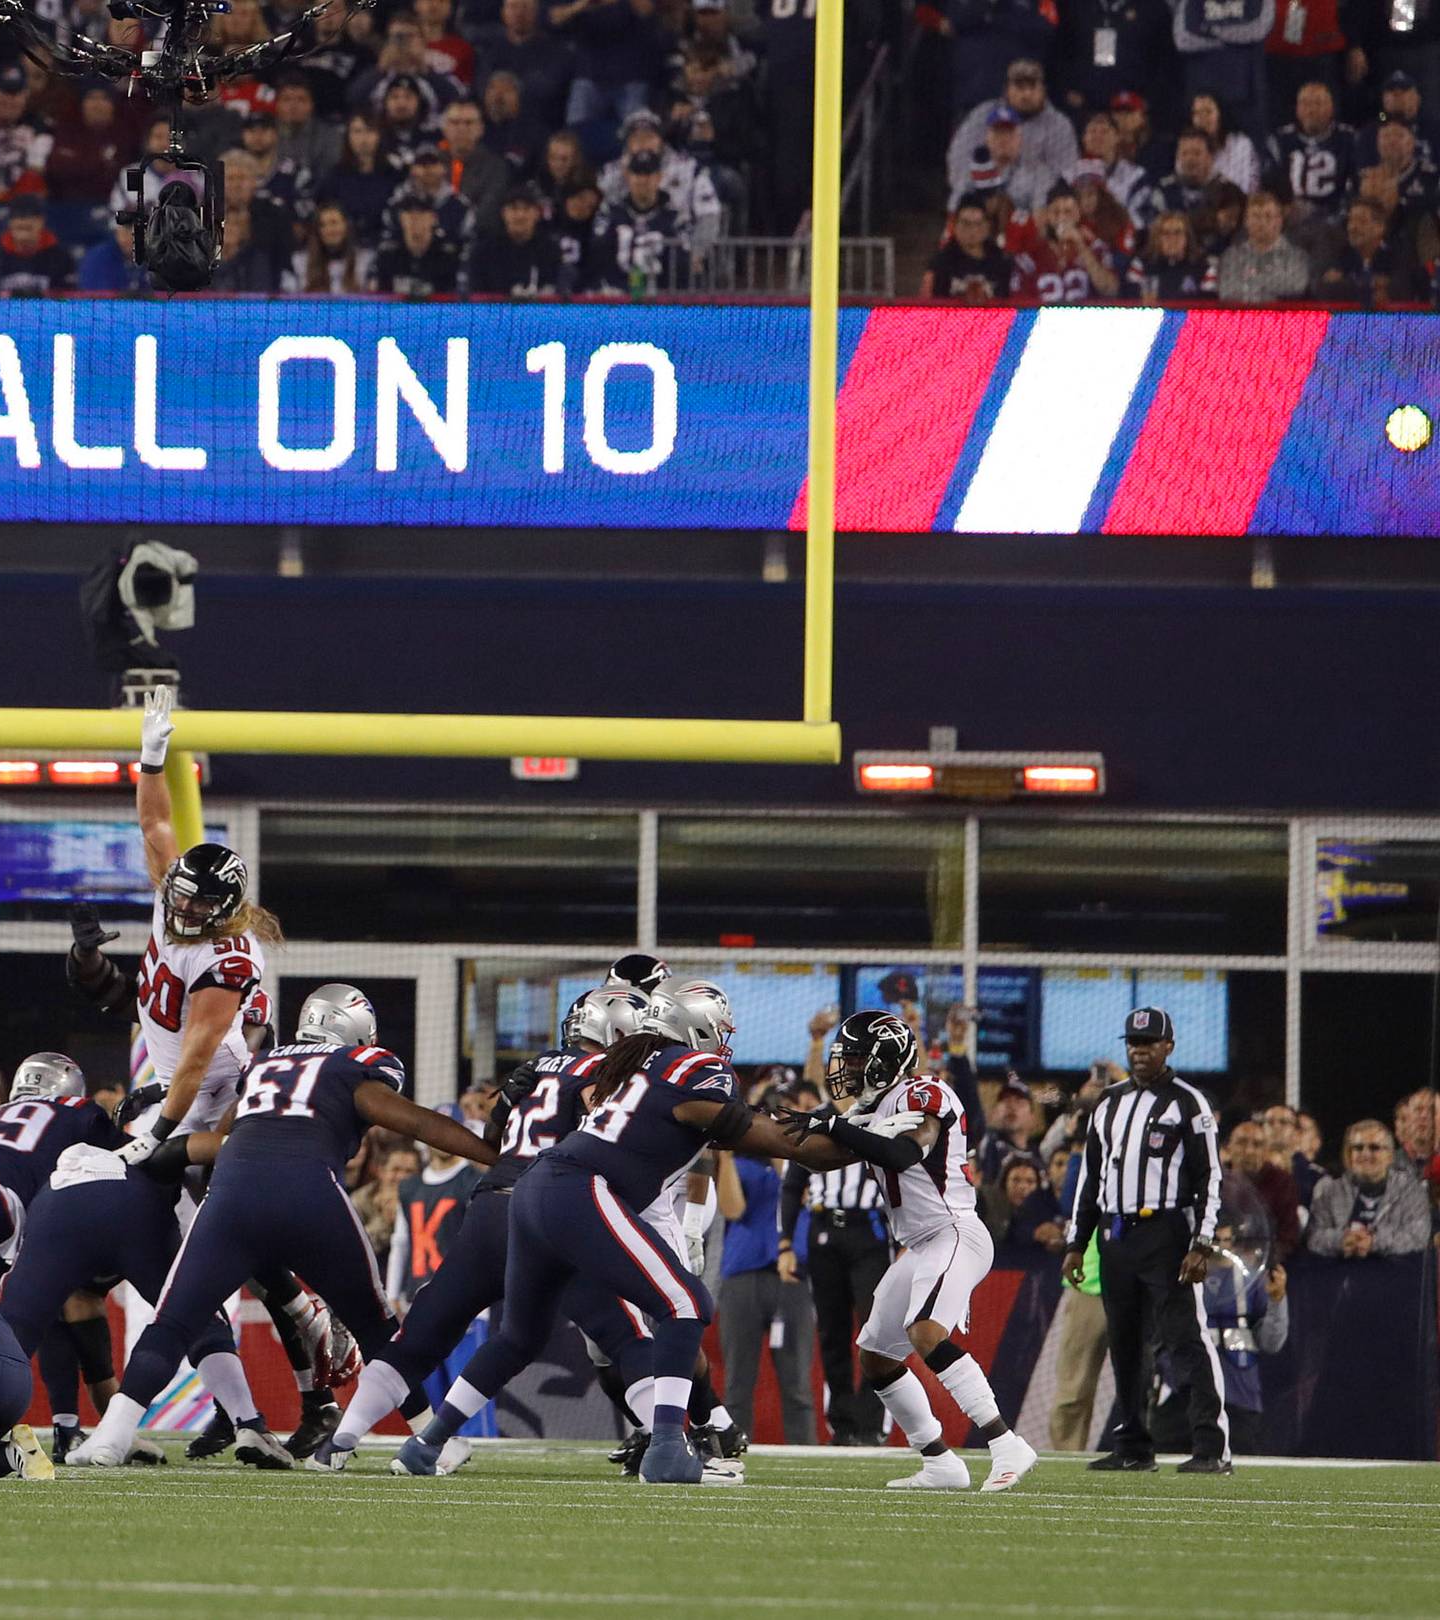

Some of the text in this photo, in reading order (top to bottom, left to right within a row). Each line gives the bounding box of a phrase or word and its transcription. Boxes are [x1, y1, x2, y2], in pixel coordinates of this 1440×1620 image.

[1289, 149, 1337, 197] 12
[258, 337, 469, 473] ON
[526, 343, 679, 475] 10
[212, 935, 251, 956] 50
[139, 934, 186, 1033] 50
[268, 1042, 344, 1058] CANNON
[308, 1014, 327, 1027] 61
[235, 1055, 329, 1119] 61
[576, 1073, 651, 1144] 8
[410, 1197, 458, 1279] K
